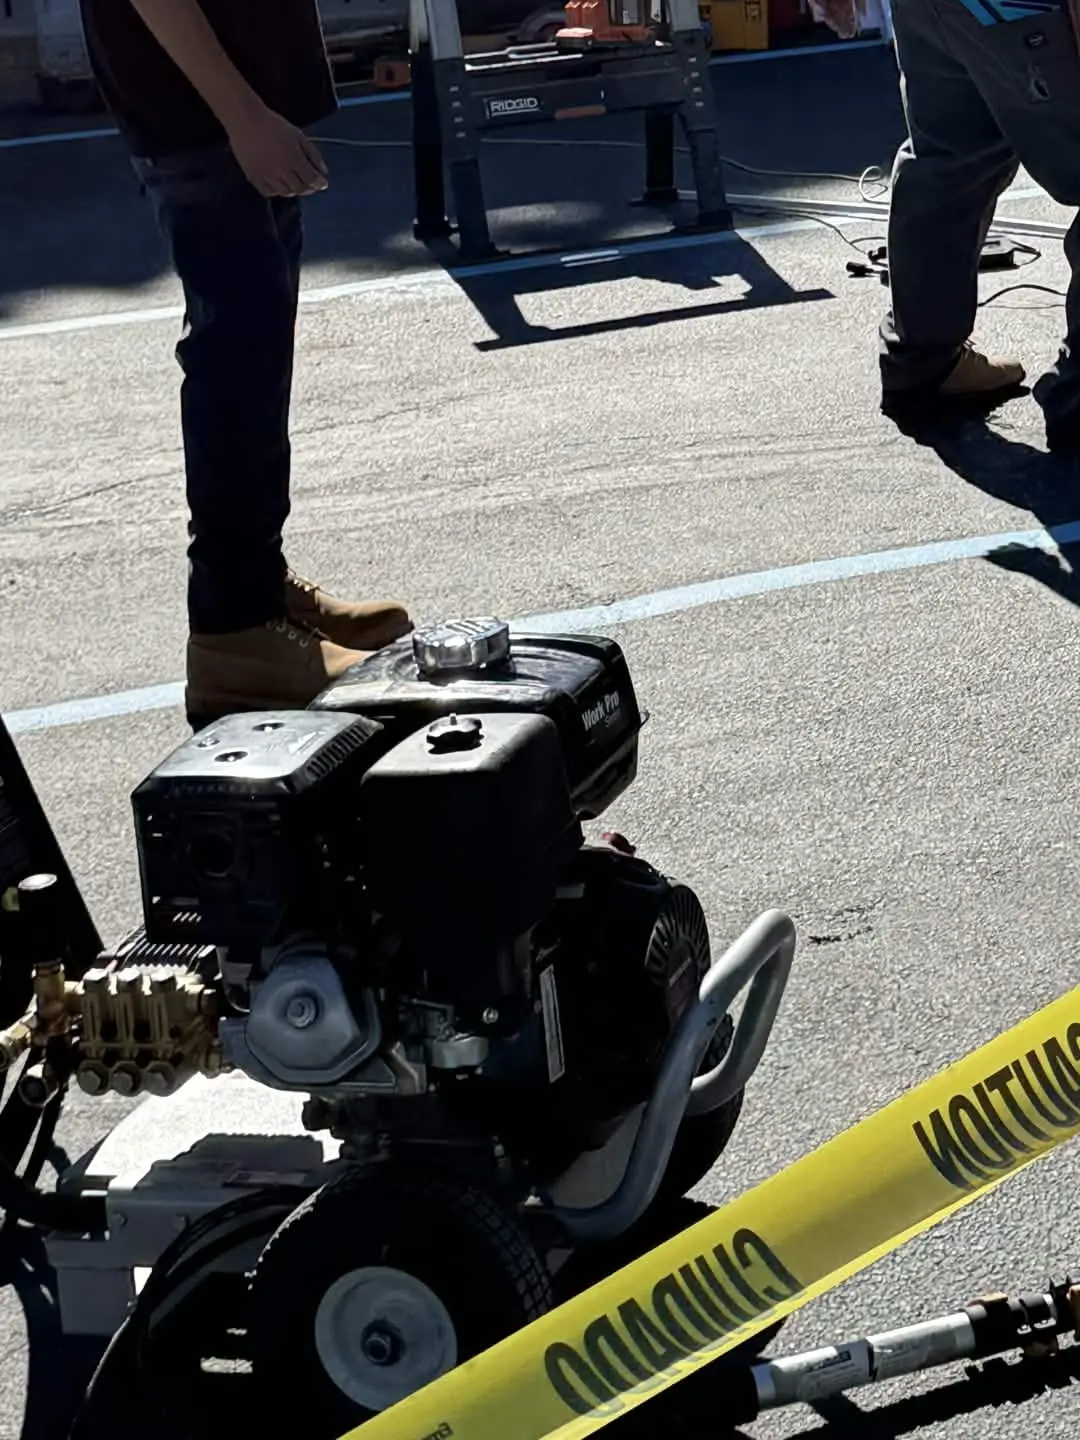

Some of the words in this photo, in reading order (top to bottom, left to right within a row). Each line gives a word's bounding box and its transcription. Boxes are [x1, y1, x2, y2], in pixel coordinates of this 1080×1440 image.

[490, 97, 538, 112] RIDGID
[581, 701, 605, 731] Work
[604, 691, 620, 713] Pro
